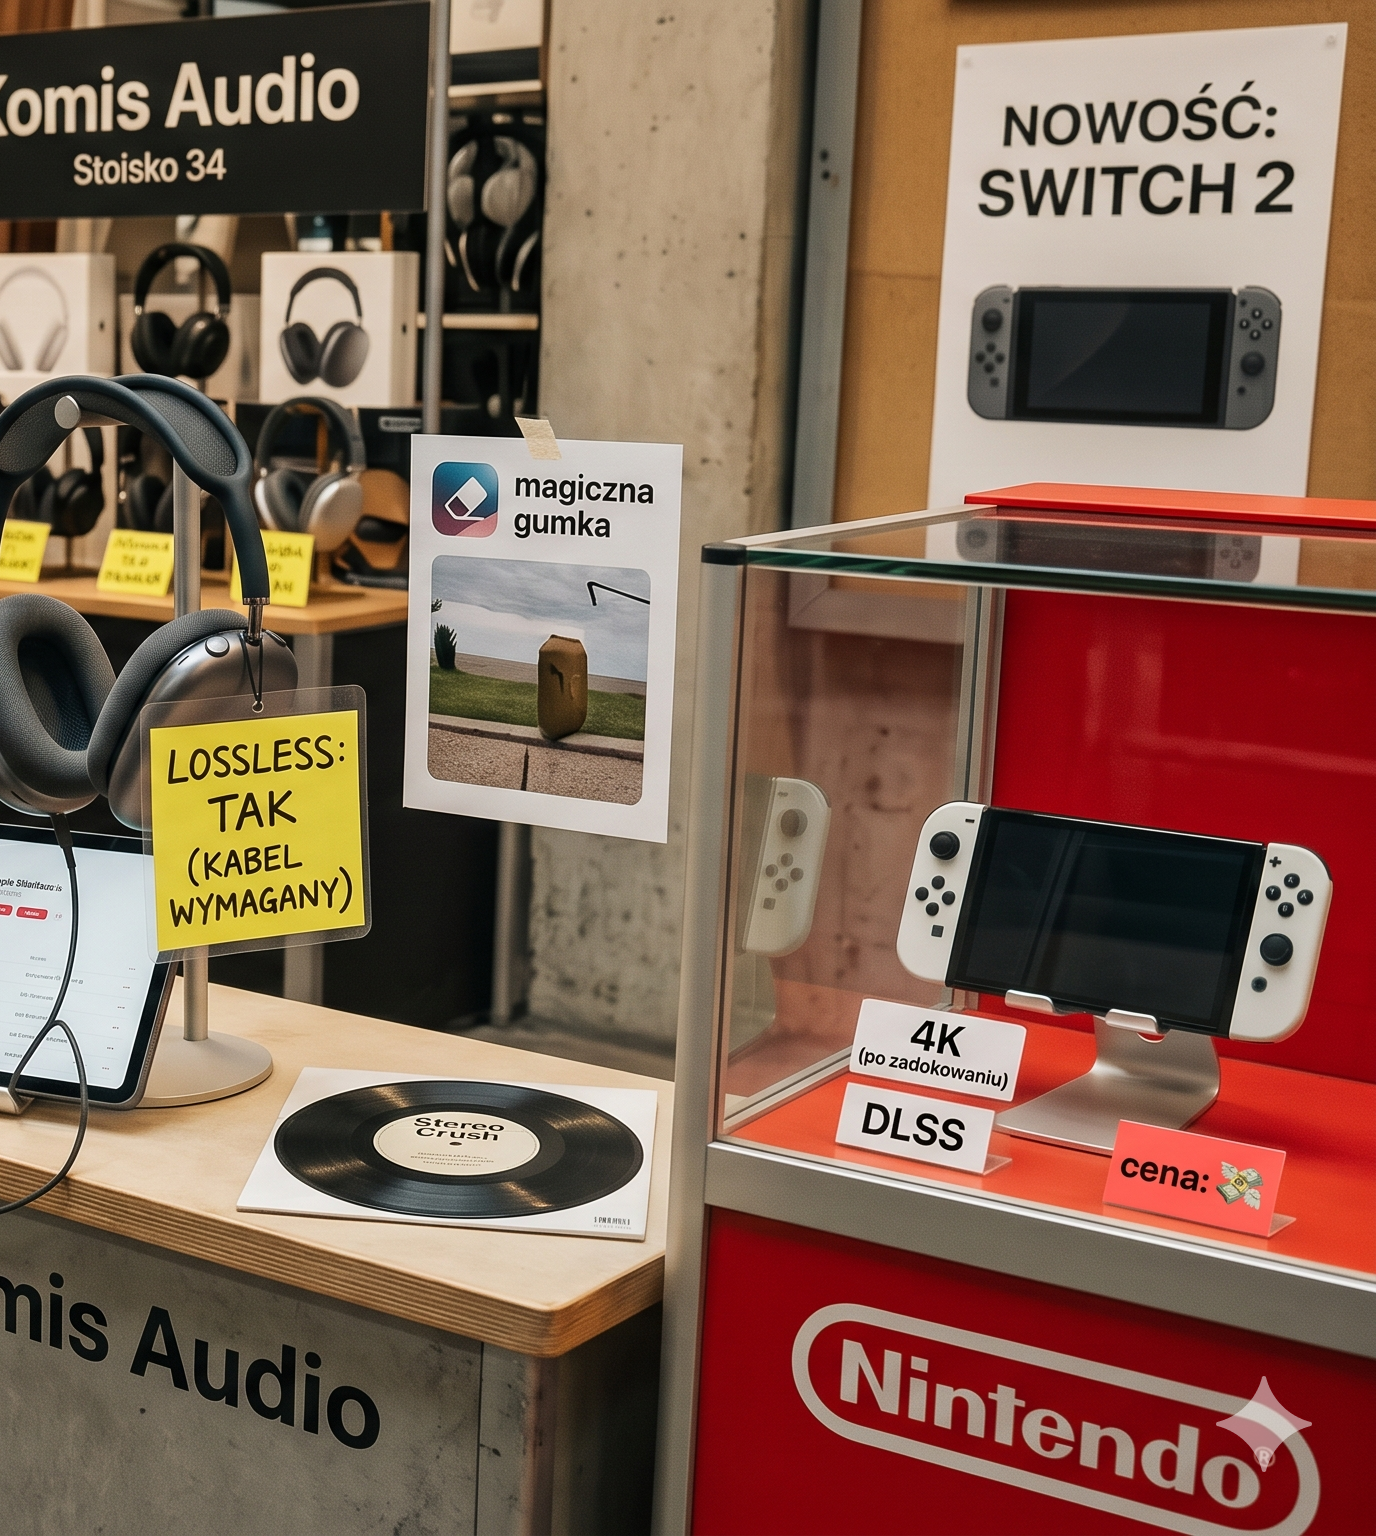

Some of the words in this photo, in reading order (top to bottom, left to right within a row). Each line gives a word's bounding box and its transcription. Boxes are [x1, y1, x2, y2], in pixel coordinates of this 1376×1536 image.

[165, 53, 359, 127] Audio
[1004, 81, 1277, 146] NOWOŚĆ:
[74, 152, 178, 185] Stoisko
[187, 149, 226, 181] 34
[979, 163, 1235, 216] SWITCH
[1255, 161, 1294, 213] 2
[516, 474, 653, 505] magiczna
[515, 511, 610, 538] gumka
[168, 735, 345, 784] LOSSLESS:
[208, 790, 296, 832] TAK
[188, 844, 303, 887] (KABEL
[170, 866, 353, 927] WYMAGANY)
[910, 1021, 966, 1057] 4K
[859, 1047, 885, 1066] (po
[888, 1056, 1008, 1091] zadokowaniu)
[414, 1118, 504, 1131] Stereo
[416, 1128, 498, 1141] Crush
[861, 1103, 965, 1152] DLSS
[1120, 1157, 1210, 1194] cena:
[130, 1305, 381, 1450] Audio
[840, 1339, 1261, 1509] Nintendo
